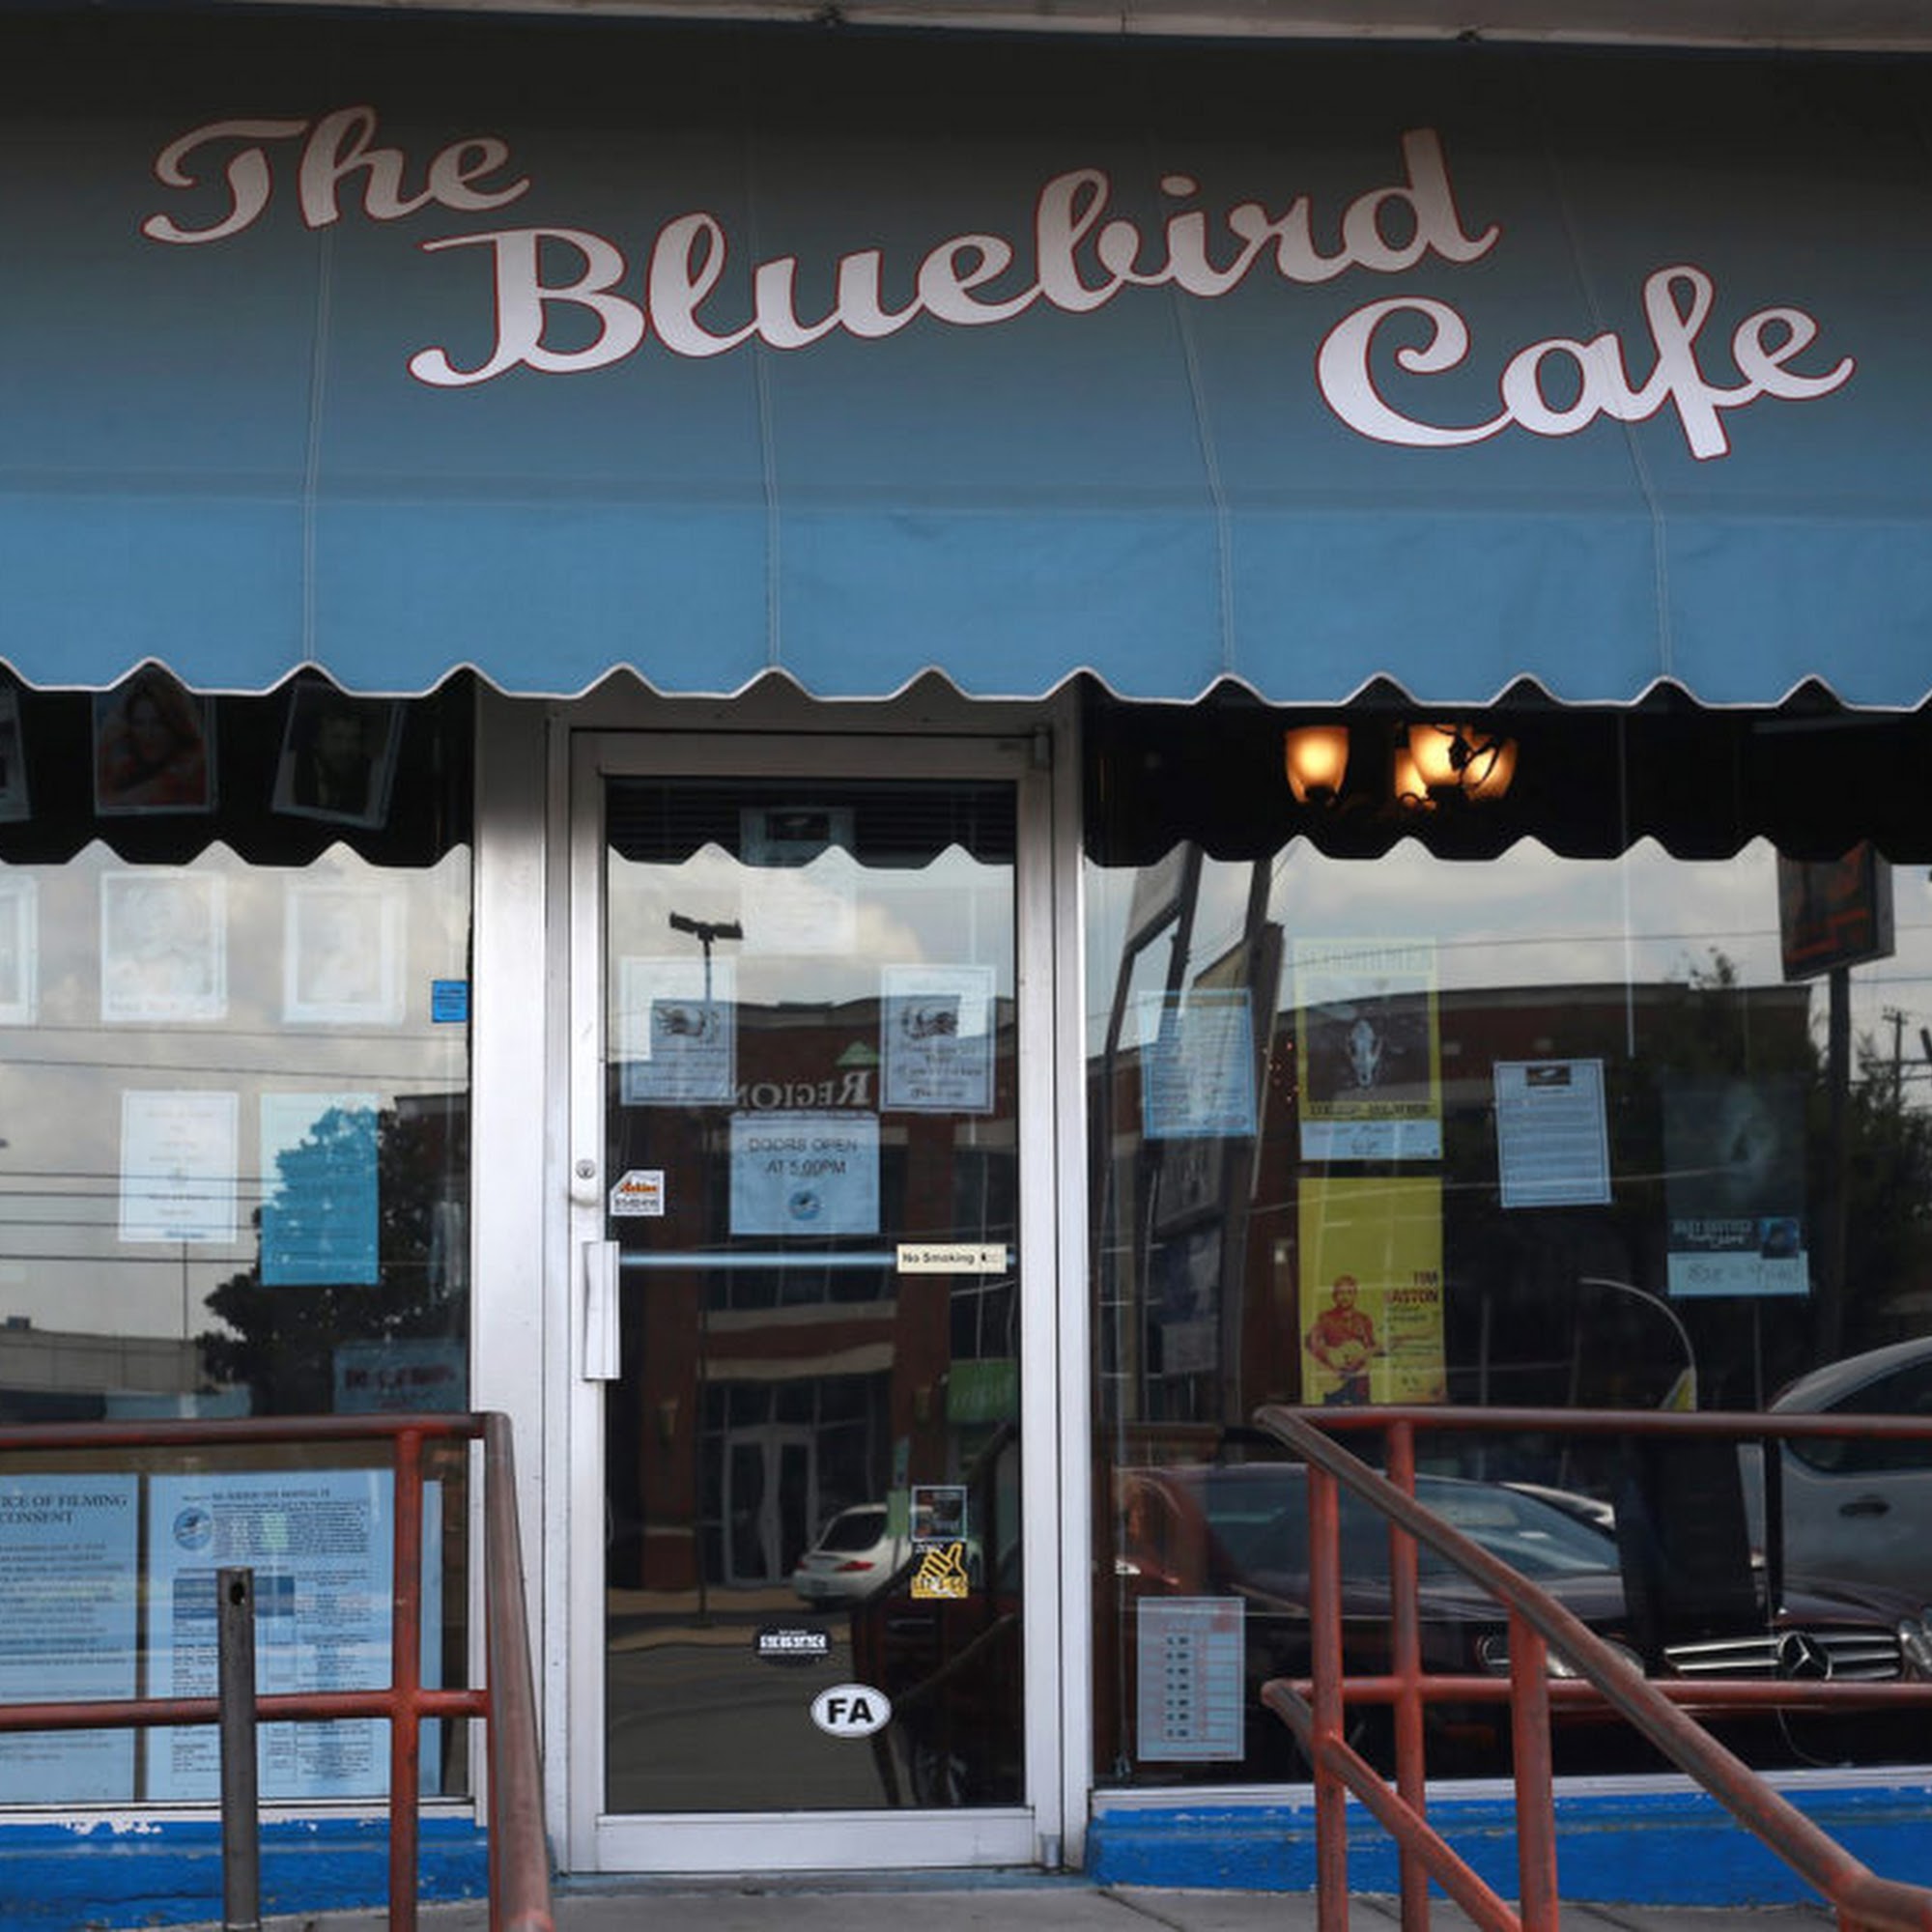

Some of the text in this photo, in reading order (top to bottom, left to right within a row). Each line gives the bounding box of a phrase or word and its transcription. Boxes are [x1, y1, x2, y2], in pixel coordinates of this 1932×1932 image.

[141, 104, 530, 243] The
[408, 128, 1499, 387] Bluebird
[1316, 264, 1856, 460] Cafe
[748, 1137, 858, 1153] DOORS OPEN
[765, 1159, 784, 1175] AT
[901, 1252, 920, 1264] No
[923, 1251, 976, 1265] Smoking
[827, 1697, 874, 1724] FA
